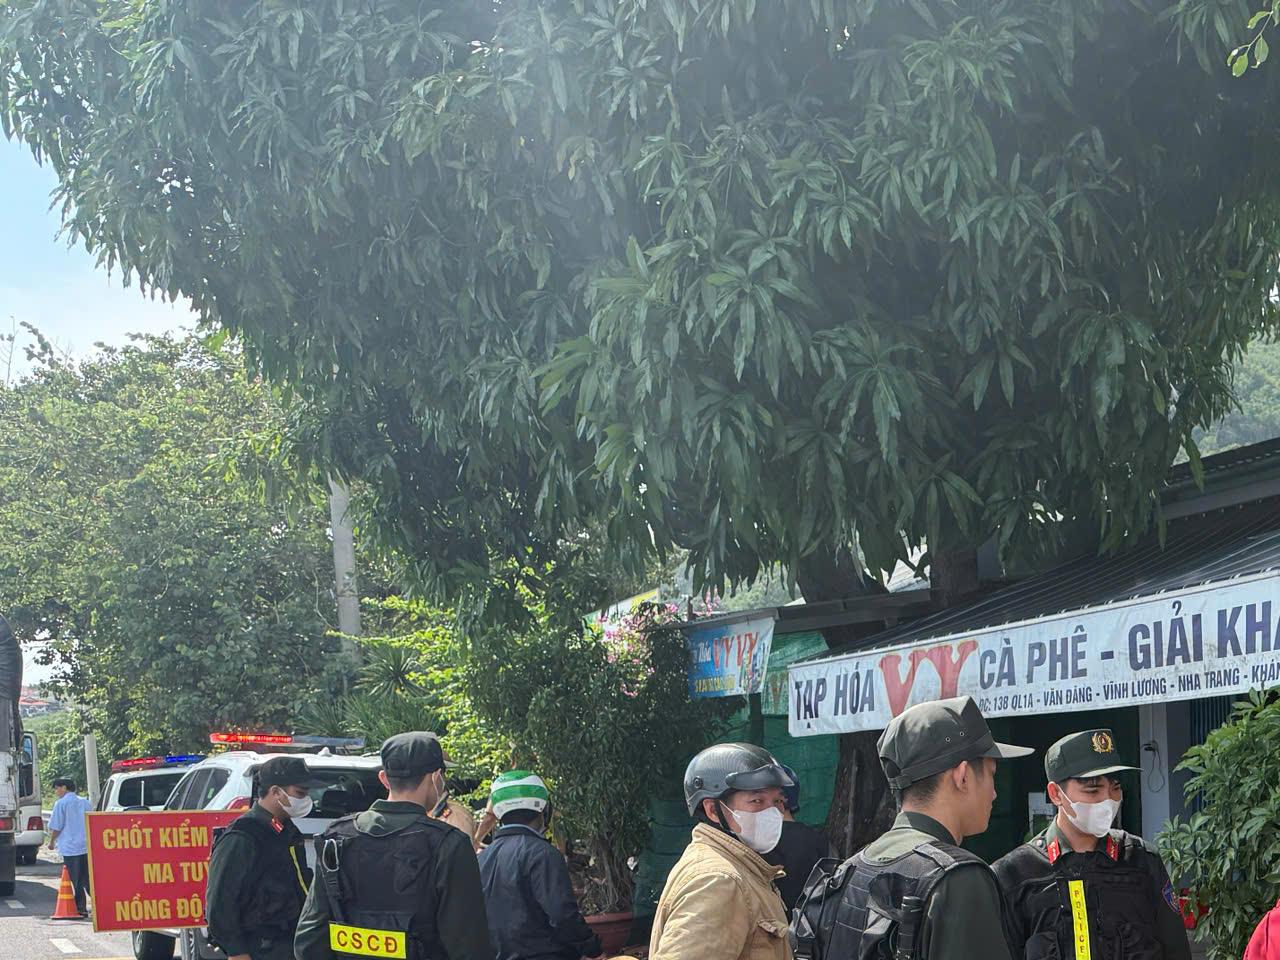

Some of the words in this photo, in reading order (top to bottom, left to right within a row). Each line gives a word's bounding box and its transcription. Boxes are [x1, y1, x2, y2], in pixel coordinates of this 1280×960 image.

[794, 677, 827, 729] TẠP
[833, 661, 876, 717] HÓA
[879, 639, 979, 718] VY
[979, 637, 1017, 690] CÀ
[1027, 624, 1089, 685] PHÊ
[1128, 600, 1204, 672] GIẢI
[1011, 693, 1034, 709] QL1A
[1103, 680, 1129, 701] VĨNH
[1131, 677, 1167, 696] LƯƠNG
[1178, 674, 1201, 692] NHA
[1204, 667, 1240, 690] TRANG
[102, 820, 153, 850] CHỐT
[159, 818, 208, 848] KIỂM
[143, 863, 175, 884] MA
[115, 892, 172, 922] NỒNG
[176, 893, 203, 923] ĐỘ
[1073, 889, 1086, 954] POLICE
[336, 929, 398, 954] CSCĐ
